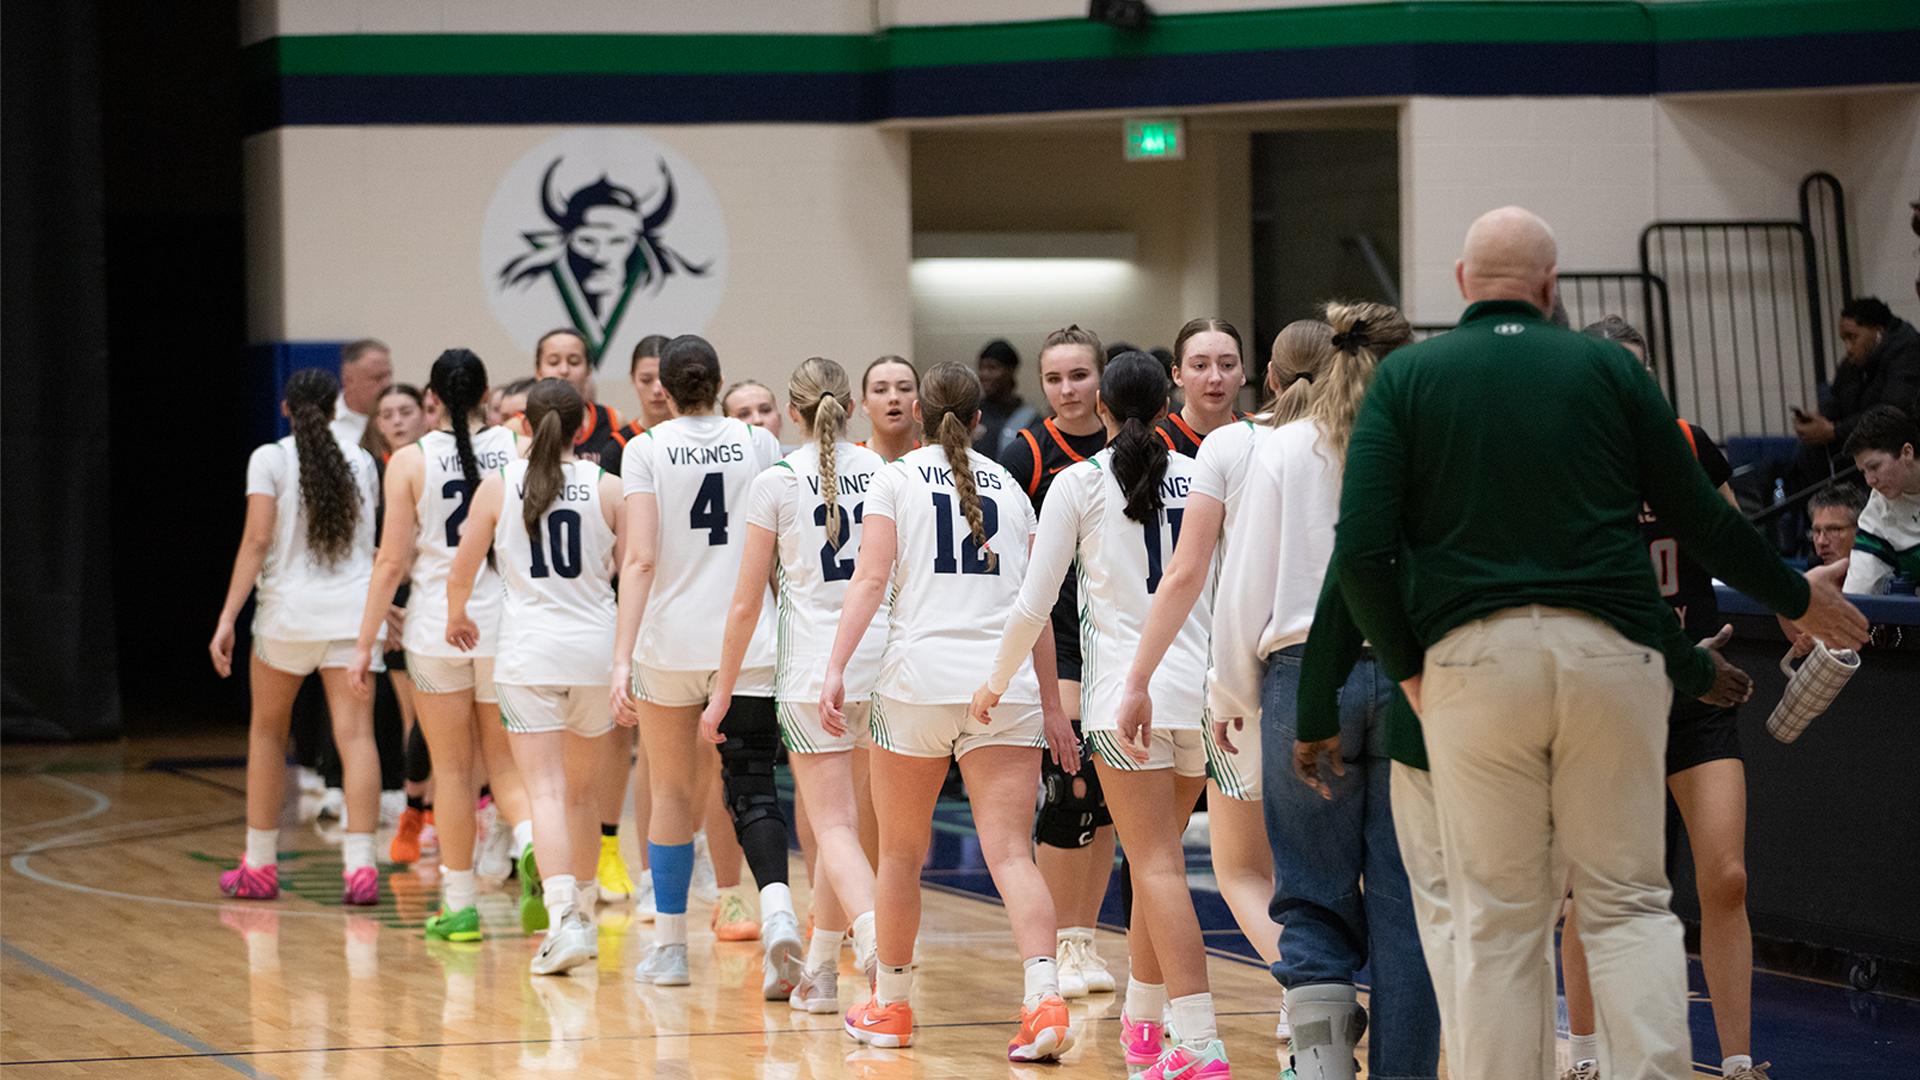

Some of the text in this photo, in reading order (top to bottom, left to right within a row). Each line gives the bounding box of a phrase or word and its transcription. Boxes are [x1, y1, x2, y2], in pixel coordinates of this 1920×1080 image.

[438, 450, 509, 472] VINGS
[666, 443, 744, 466] VIKINGS
[806, 472, 876, 496] VING
[917, 466, 1002, 490] VIKGS
[690, 472, 728, 547] 4
[529, 509, 583, 580] 10
[931, 492, 1000, 577] 12
